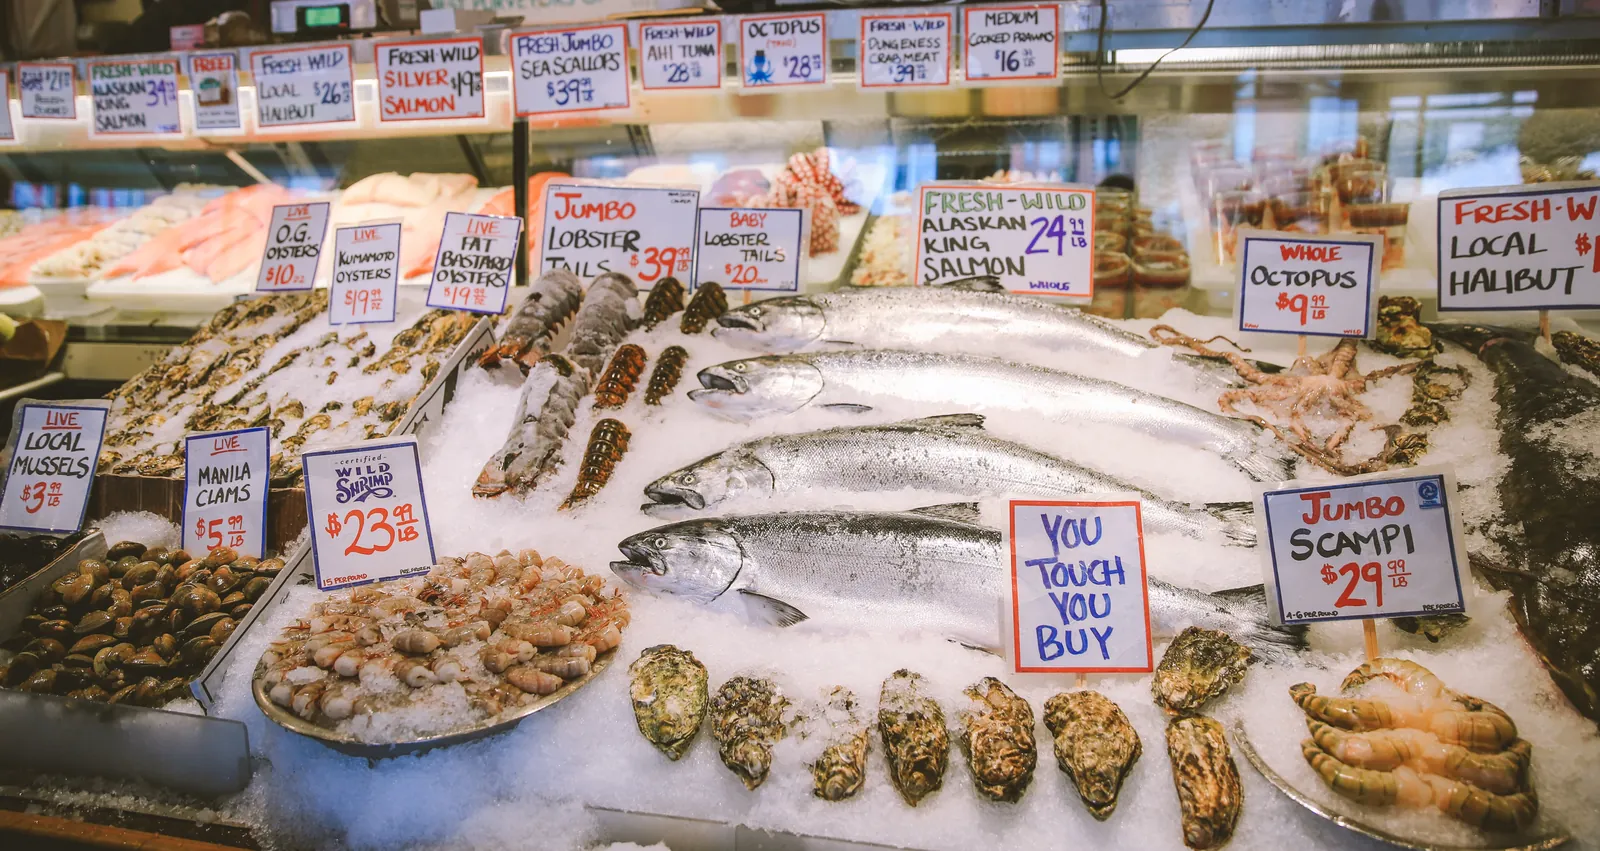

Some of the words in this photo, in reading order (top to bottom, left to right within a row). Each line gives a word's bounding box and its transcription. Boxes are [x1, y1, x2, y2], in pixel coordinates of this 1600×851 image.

[985, 10, 1039, 27] MEDIUM
[749, 19, 820, 38] OCTOPUS
[518, 36, 559, 56] FRESH
[562, 33, 613, 52] JUMBO
[869, 37, 941, 50] DUNGENESS
[969, 32, 1010, 46] COOKED
[1013, 31, 1055, 43] PRAWNS
[648, 45, 673, 61] AHI
[678, 44, 715, 58] TUNA
[870, 53, 901, 65] CRAB
[903, 51, 939, 62] MEAT
[194, 56, 231, 72] FREE!
[262, 55, 301, 75] FRESH
[308, 51, 344, 70] WILD
[521, 60, 551, 79] SEA
[553, 52, 620, 76] SCALLOPS
[385, 68, 448, 88] SILVER
[260, 82, 300, 100] LOCAL
[547, 79, 580, 105] $39
[96, 97, 130, 111] KING
[260, 104, 316, 123] HALIBUT
[385, 93, 455, 115] SALMON
[97, 113, 146, 132] SALMON
[287, 206, 309, 217] LIVE
[554, 192, 636, 222] JUMBO
[467, 218, 500, 235] LIVE
[730, 212, 767, 228] BABY
[923, 216, 1027, 233] ALASKAN
[276, 223, 311, 244] O.G.
[354, 229, 380, 241] LIVE
[549, 226, 641, 253] LOBSTER
[705, 231, 770, 246] LOBSTER
[1025, 215, 1066, 256] 24
[1071, 237, 1087, 248] LB
[266, 244, 319, 260] OYSTERS
[461, 236, 498, 253] FAT
[924, 236, 990, 254] KING
[1280, 244, 1343, 263] WHOLE
[1451, 231, 1548, 259] LOCAL
[339, 251, 395, 267] KUMAMOTO
[440, 250, 513, 271] BASTARD
[629, 247, 678, 282] $39
[741, 249, 785, 262] TAILS
[336, 269, 391, 283] OYSTERS
[436, 269, 508, 288] OYSTERS
[924, 256, 1025, 282] SALMON
[1251, 265, 1357, 289] OCTOPUS
[1029, 281, 1070, 291] WHOLE
[1450, 265, 1584, 296] HALIBUT
[344, 289, 369, 316] $19
[1275, 292, 1308, 326] $9
[46, 410, 80, 426] LIVE
[25, 432, 85, 452] LOCAL
[214, 436, 240, 451] LIVE
[12, 456, 89, 479] MUSSELS
[198, 462, 251, 486] MANILA
[335, 463, 390, 477] WILD
[196, 484, 250, 507] CLAMS
[336, 472, 393, 503] SHRIMP
[20, 482, 47, 514] $3
[1301, 491, 1405, 525] JUMBO
[195, 517, 223, 551] $5
[325, 508, 395, 556] $23
[398, 526, 419, 542] LB
[1040, 513, 1103, 556] YOU
[1290, 524, 1415, 561] SCAMPI
[1025, 555, 1126, 589] TOUCH
[323, 578, 333, 586] 15
[1320, 562, 1383, 608] $29
[1387, 559, 1405, 573] 99
[1392, 576, 1408, 588] LB
[1048, 592, 1112, 625] YOU
[1036, 625, 1113, 661] BUY
